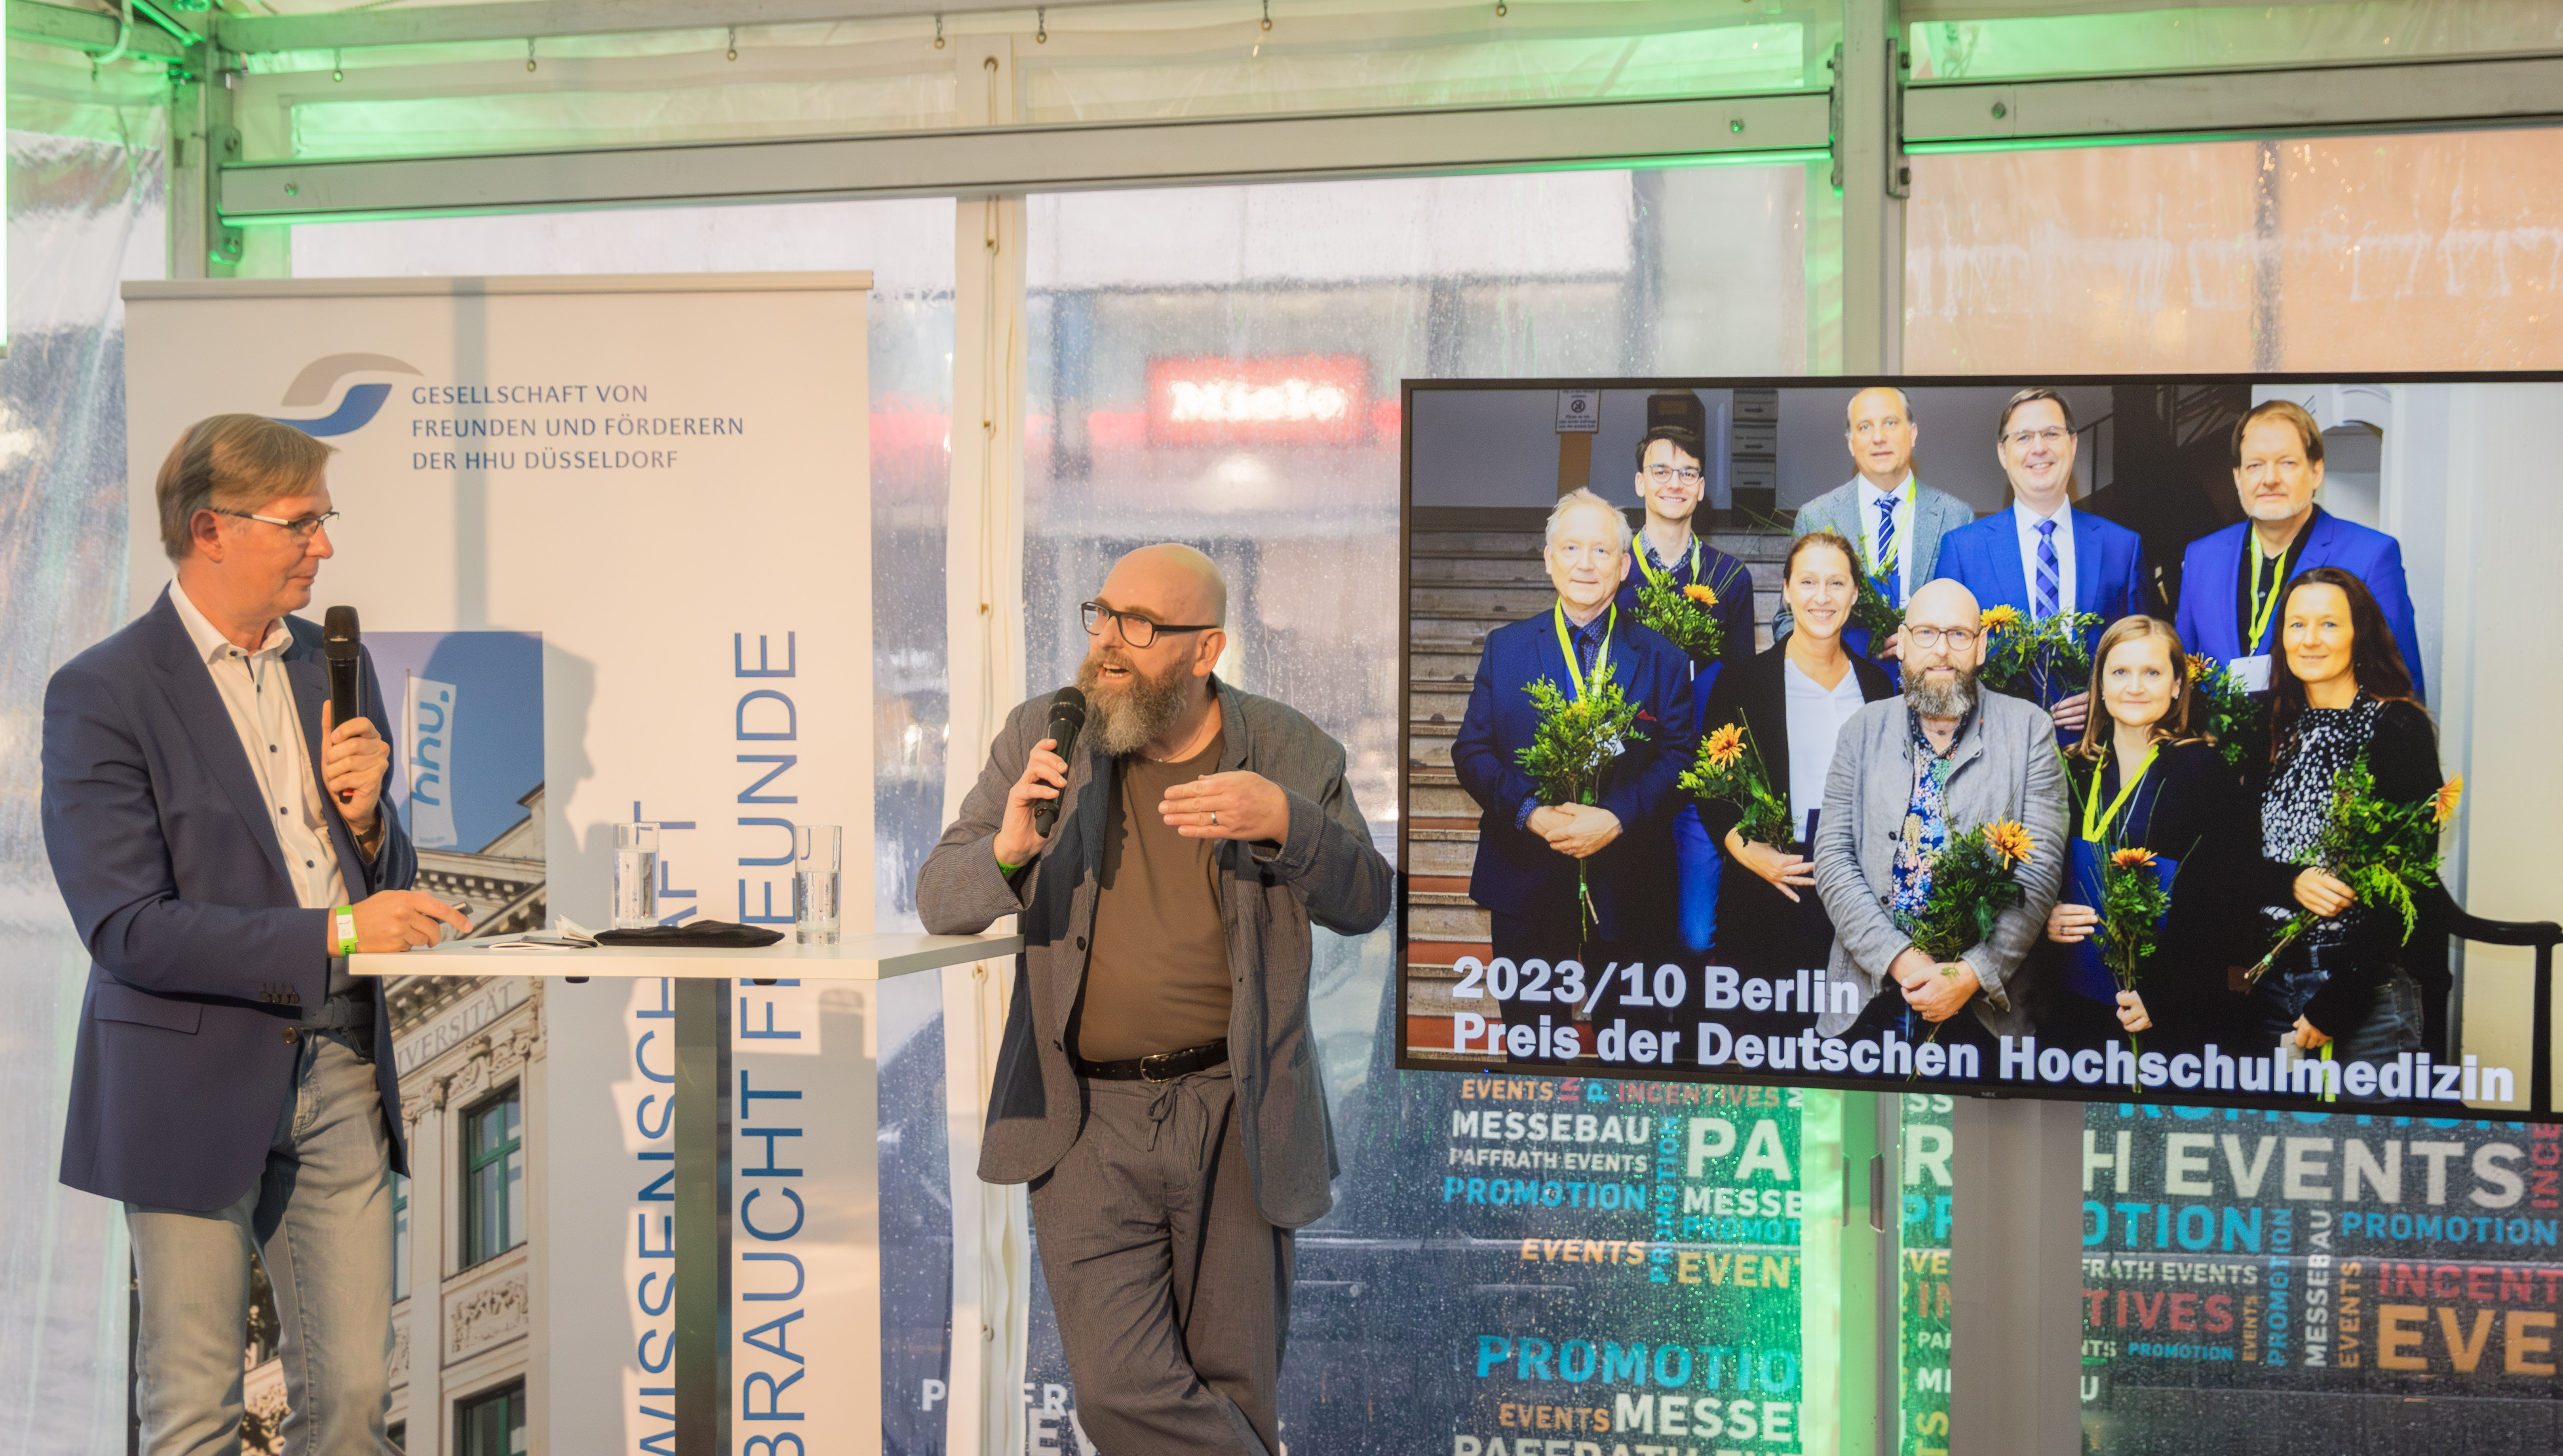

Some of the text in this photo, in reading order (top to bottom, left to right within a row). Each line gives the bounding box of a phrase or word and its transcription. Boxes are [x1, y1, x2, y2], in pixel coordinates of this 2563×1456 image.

[412, 384, 647, 405] GESELLSCHAFT VON
[413, 413, 743, 437] FREUNDEN UND FÖRDERERN
[413, 447, 678, 470] DER HHU DÜSSELDORF
[734, 631, 802, 1039] FEUNDE
[1452, 955, 1860, 1015] 2023/10 Berlin
[1453, 1011, 2515, 1103] Preis der Deutschen Hochschulmedizin
[1461, 1078, 1554, 1101] EVENTS
[1618, 1082, 1780, 1107] INCENTIVES
[633, 800, 698, 1456] WISSENSCHFT
[1452, 1109, 1650, 1145] MESSEBAU
[1449, 1147, 1648, 1174] PAFFRATH EVENTS
[2165, 1132, 2525, 1209] EVENTS
[1442, 1176, 1647, 1212] PROMOTION
[1649, 1116, 1680, 1283] PROMOTION
[2341, 1211, 2558, 1247] PROMOTION
[1521, 1238, 1647, 1265] EVENTS
[1677, 1252, 1801, 1289] EVEN
[2162, 1262, 2259, 1285] EVENTS
[2267, 1208, 2293, 1367] PROMOTION
[2304, 1209, 2334, 1367] MESSEBAU
[2242, 1295, 2259, 1361] EVENTS
[2338, 1261, 2363, 1369] EVENTS
[2128, 1341, 2234, 1361] PROMOTION
[1499, 1403, 1610, 1433] EVENTS
[1614, 1393, 1802, 1443] MESSE
